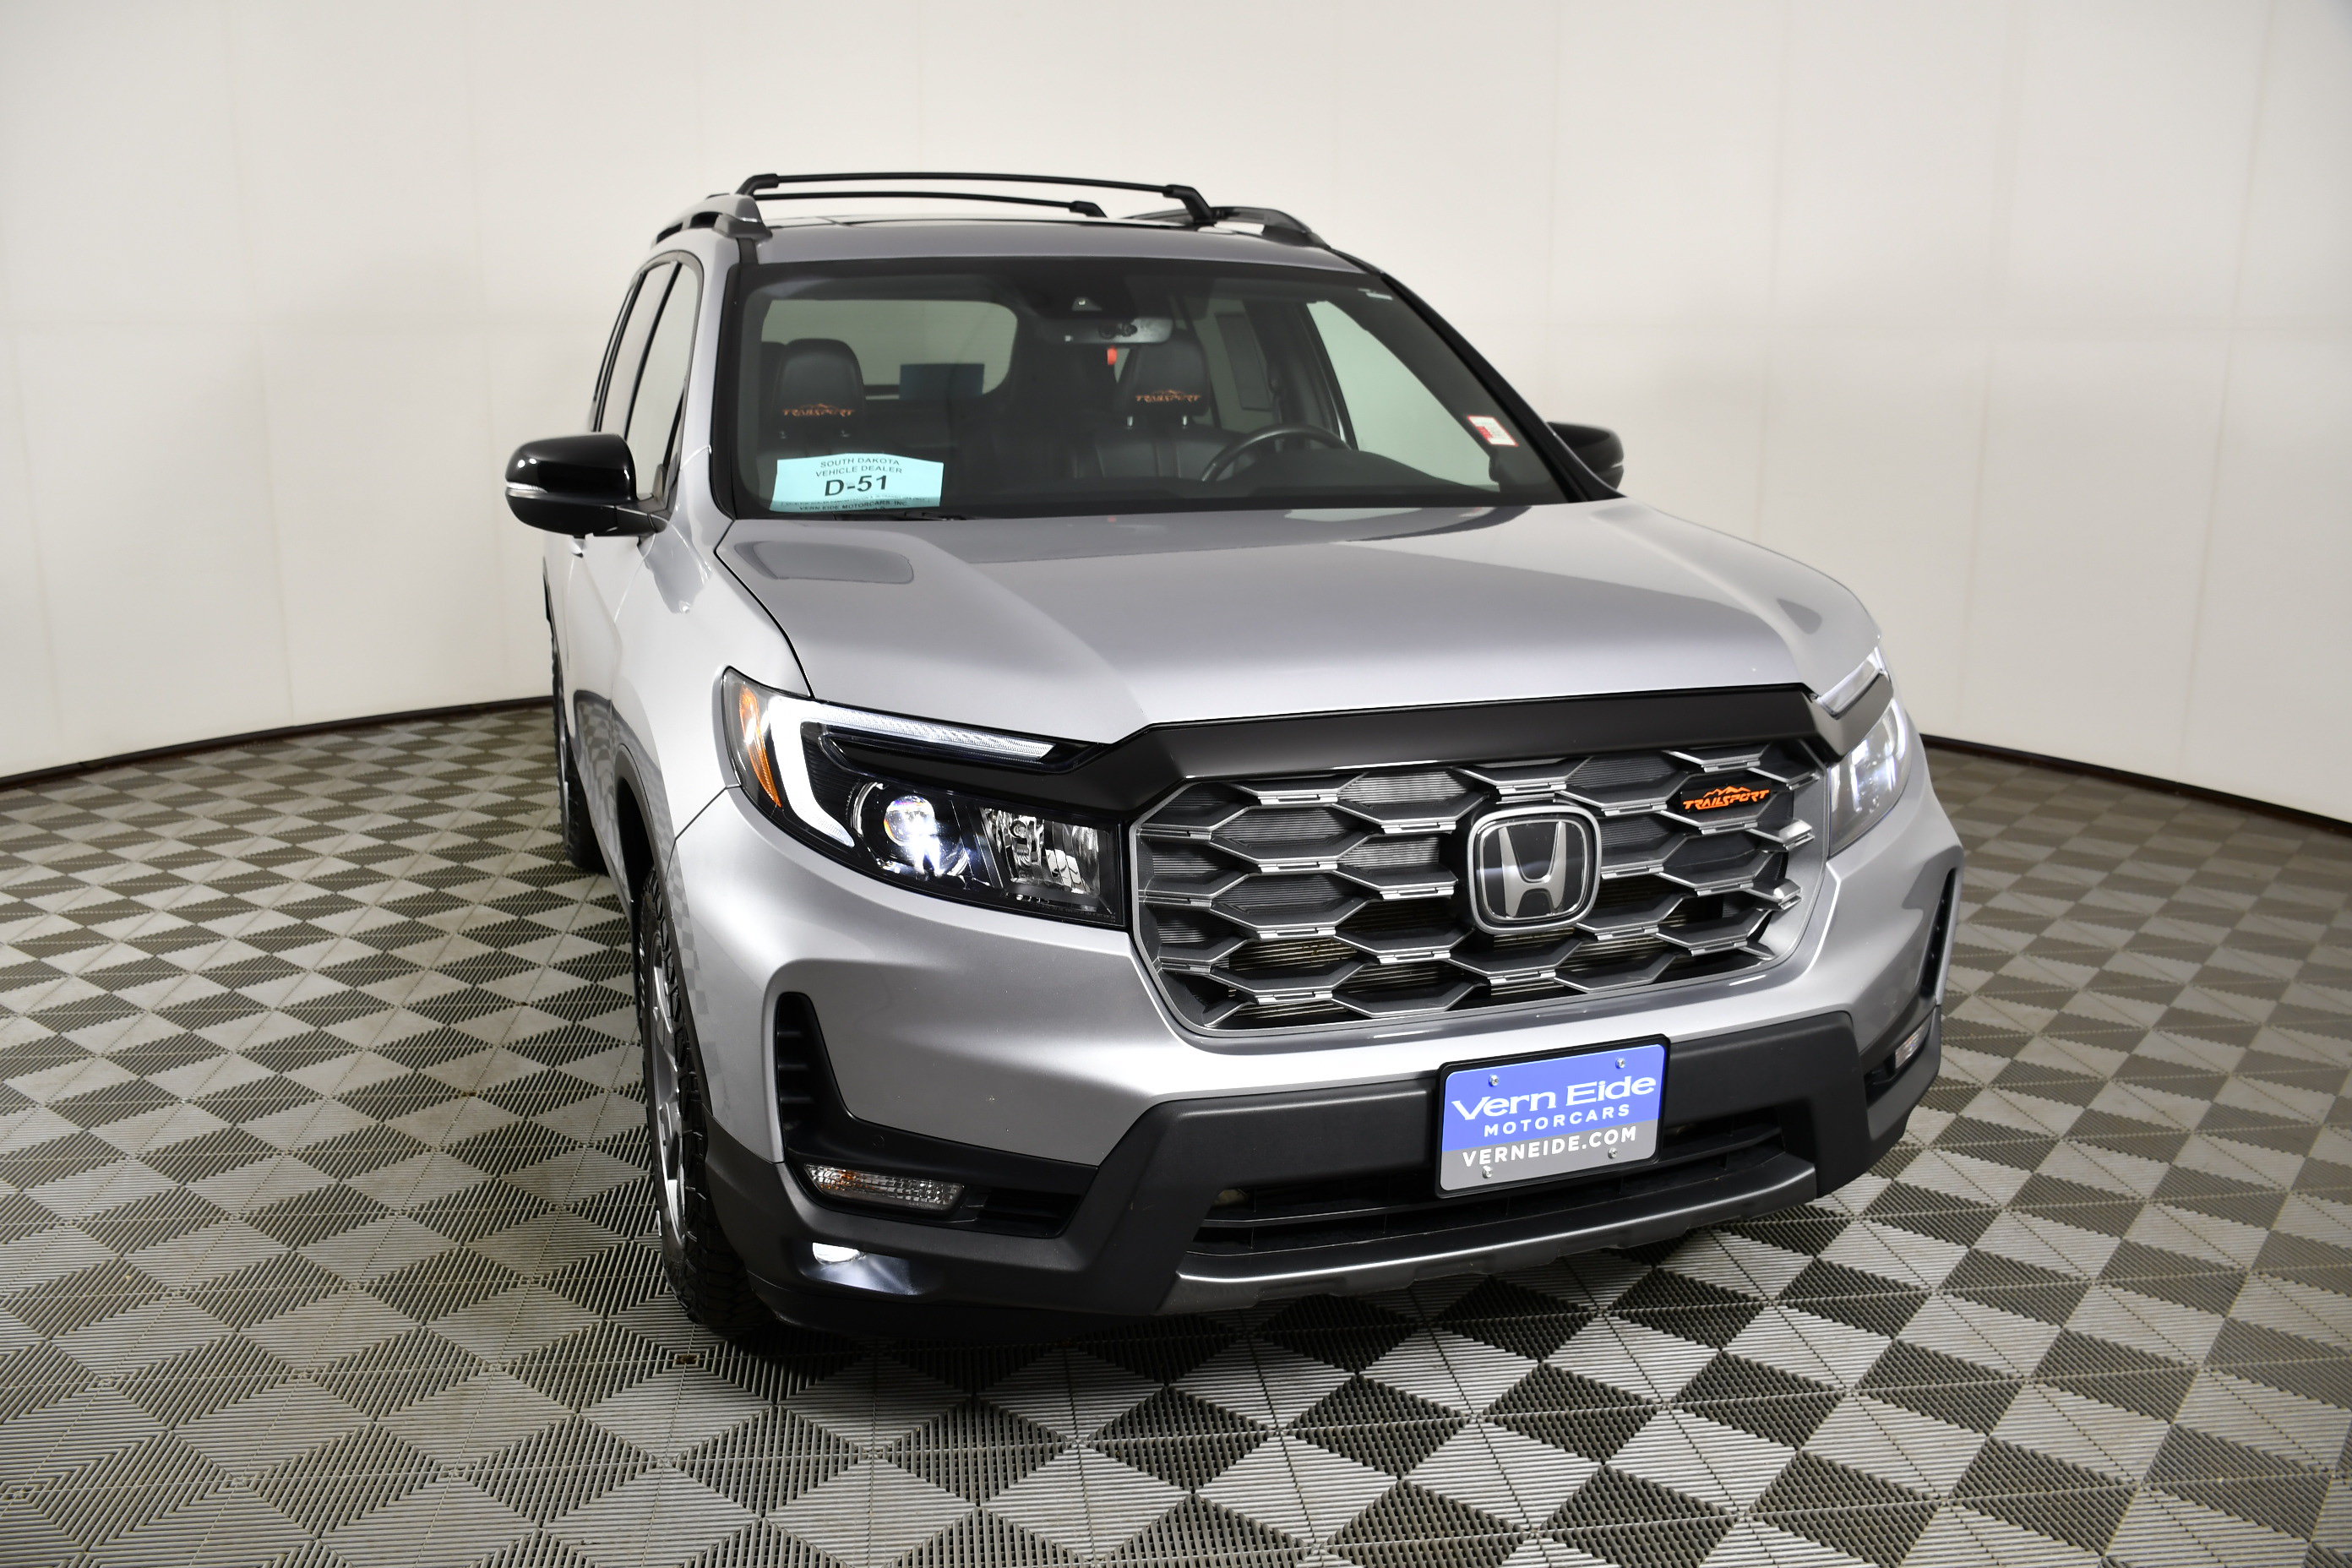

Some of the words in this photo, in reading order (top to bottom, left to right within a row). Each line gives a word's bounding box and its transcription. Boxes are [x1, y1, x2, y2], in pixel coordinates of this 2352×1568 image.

[816, 466, 858, 477] VEHICLE
[861, 466, 902, 474] DEALER
[820, 458, 854, 468] SOUTH
[825, 475, 887, 496] D-51
[1683, 789, 1770, 809] TRAILSPORT
[1451, 1091, 1557, 1121] Vern
[1565, 1075, 1657, 1107] Eide
[1484, 1103, 1630, 1138] MOTORCARS
[1462, 1125, 1637, 1168] VERNEIDE.COM
